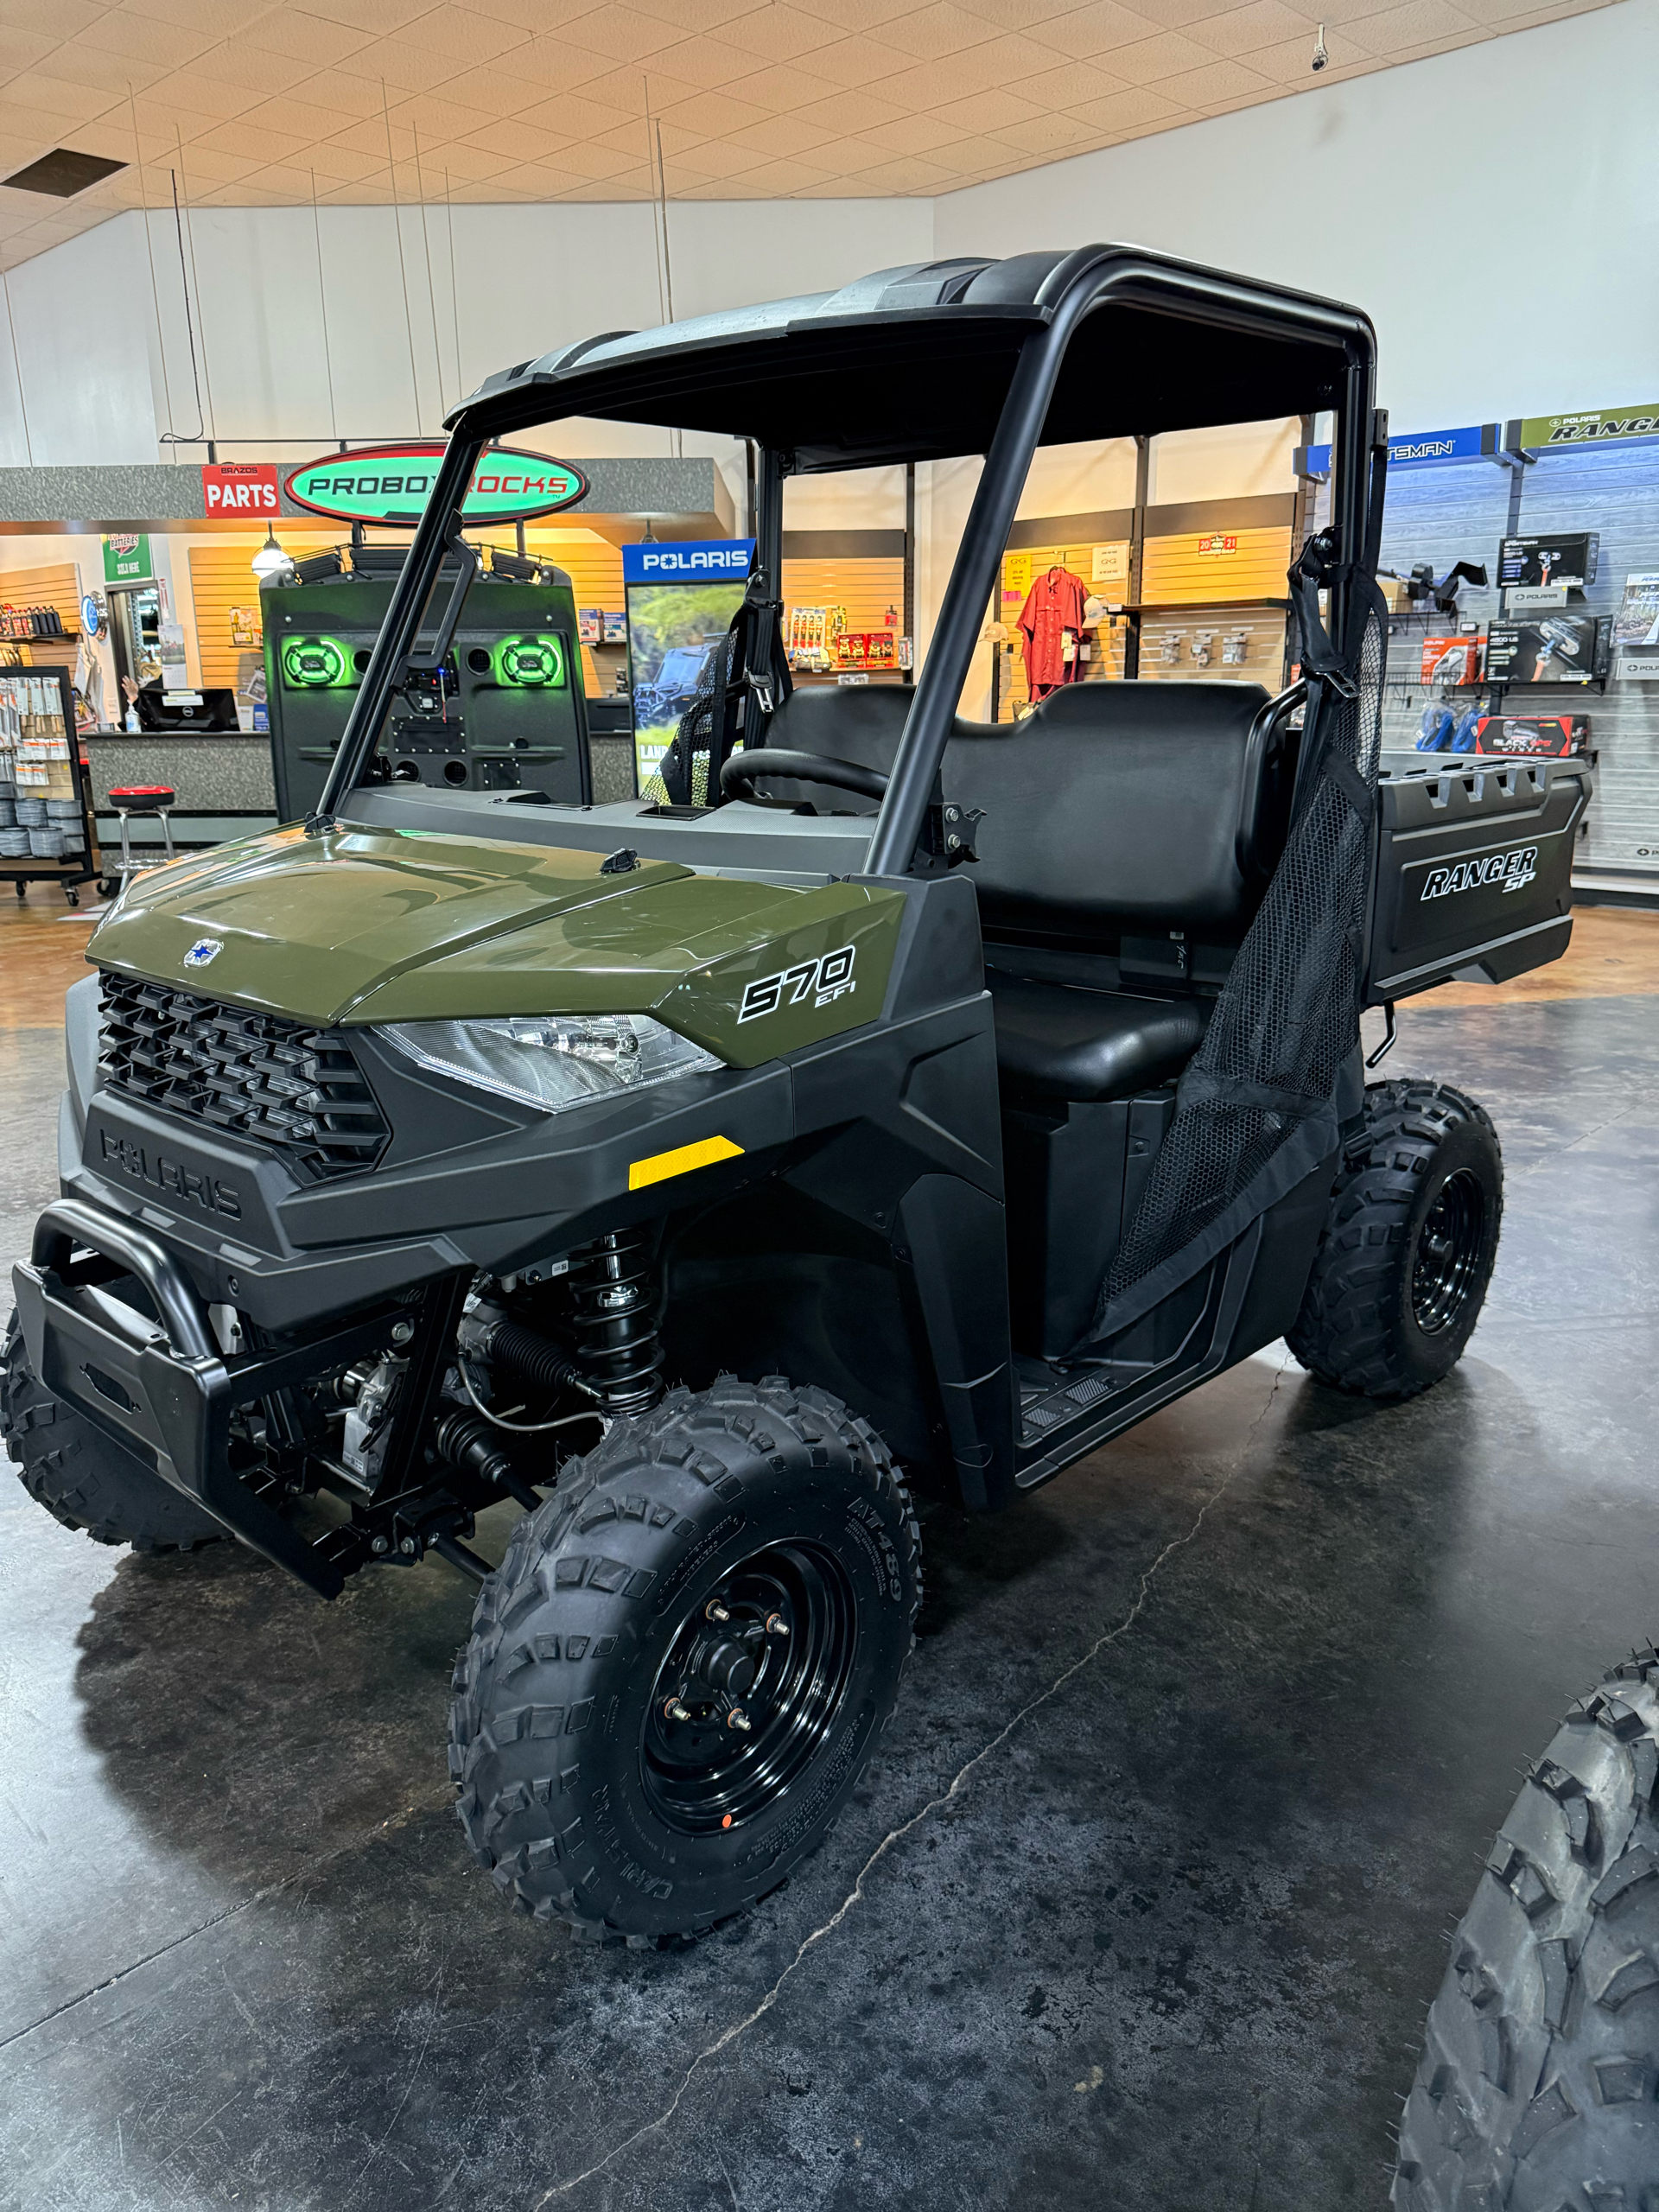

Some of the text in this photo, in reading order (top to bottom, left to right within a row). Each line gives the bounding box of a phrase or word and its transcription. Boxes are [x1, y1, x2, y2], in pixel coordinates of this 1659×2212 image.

[1562, 415, 1601, 425] POLARIS
[207, 484, 276, 507] PARTS
[467, 476, 568, 493] OCKS
[111, 536, 138, 548] BATTERIES
[1199, 540, 1210, 550] 20
[1226, 537, 1236, 548] 21
[643, 550, 748, 570] POLARIS
[1420, 846, 1538, 901] RANGER
[1502, 872, 1536, 893] SP
[737, 944, 856, 1025] 570
[814, 981, 856, 1008] EFI
[100, 1128, 242, 1222] POLARIS
[847, 1496, 886, 1529] AT
[877, 1530, 902, 1602] 489
